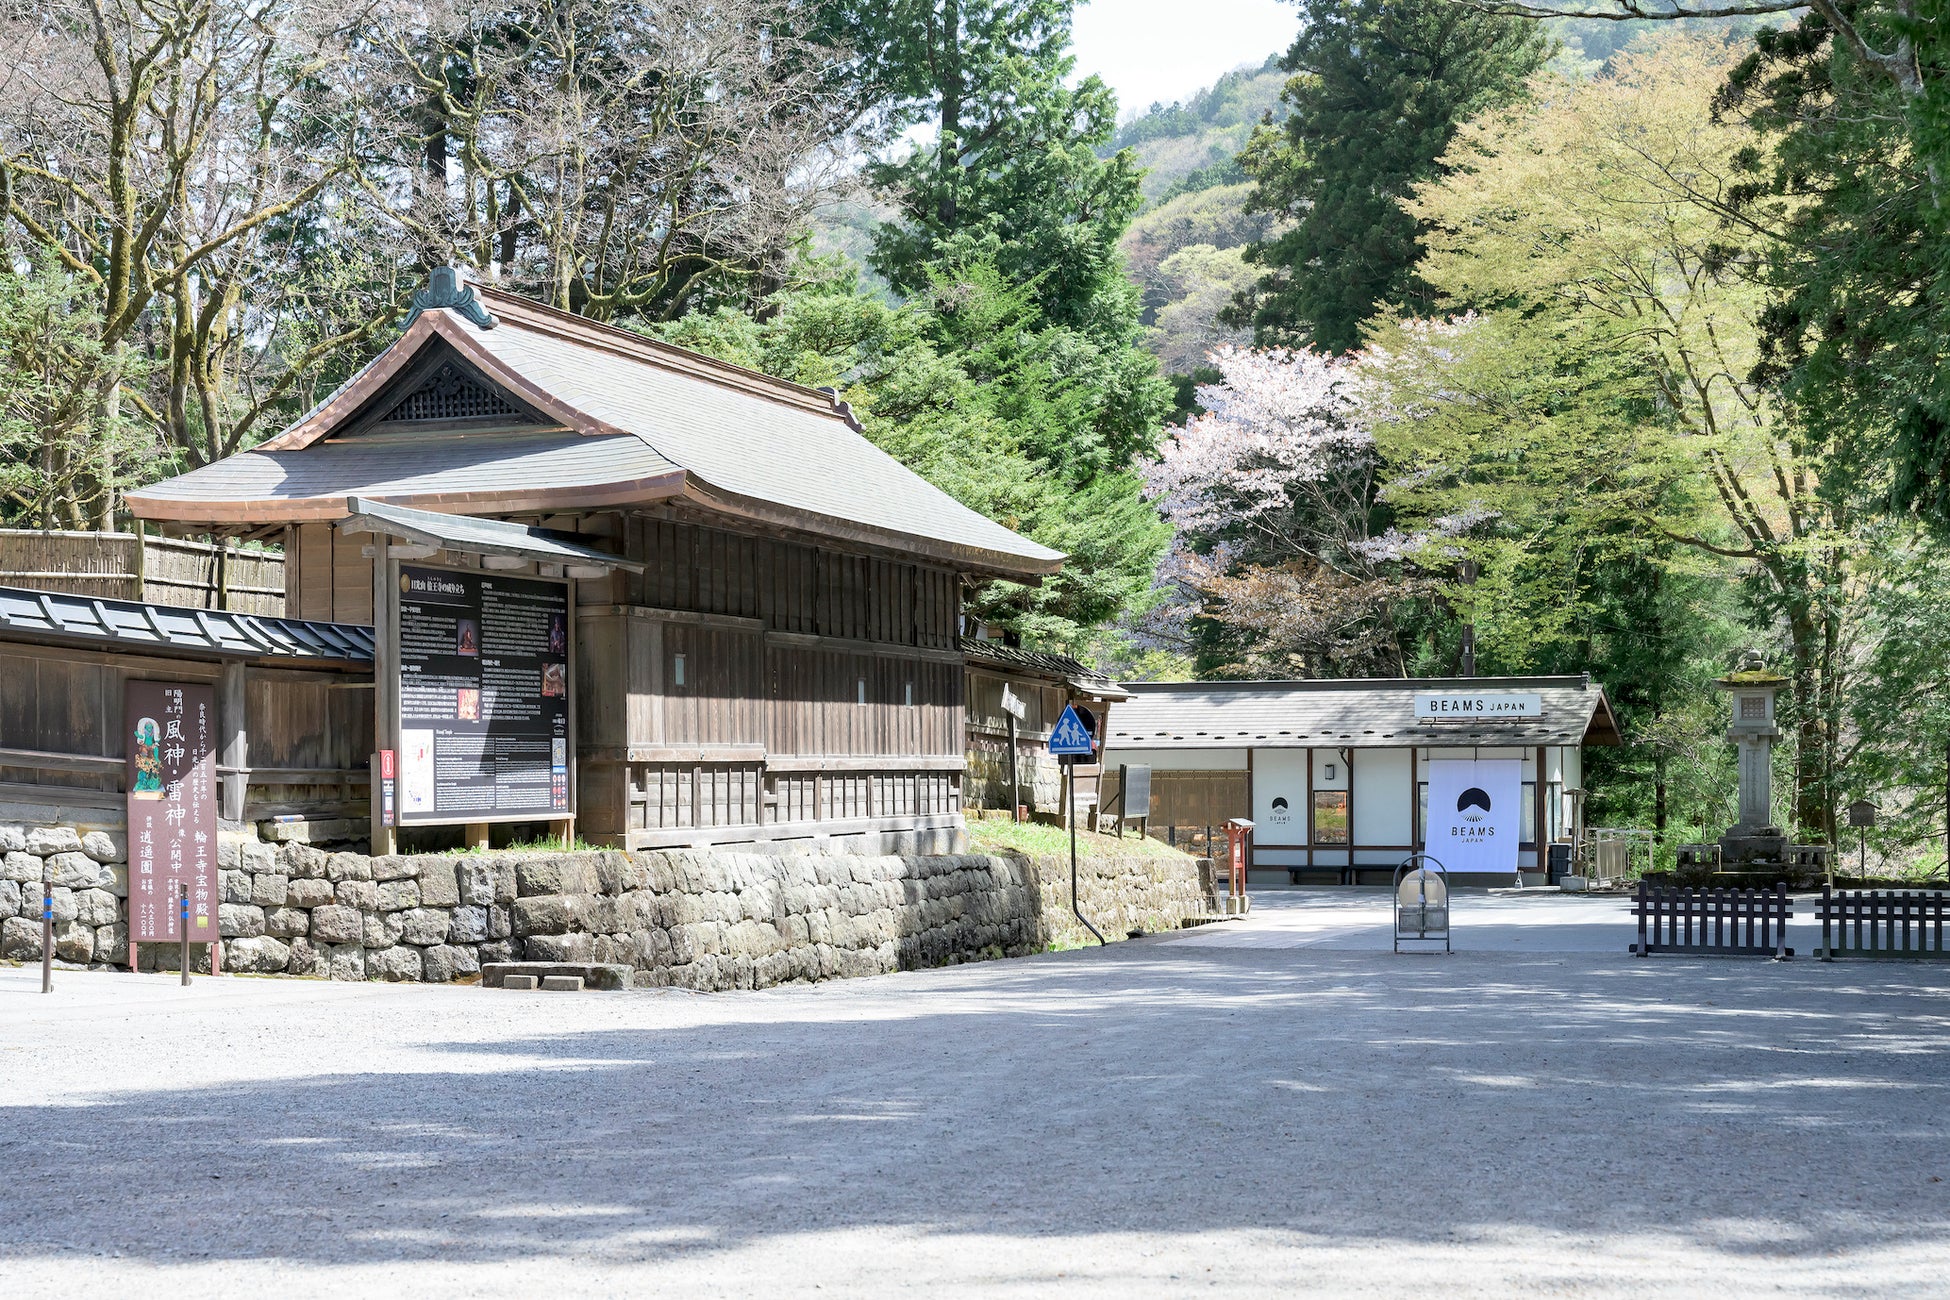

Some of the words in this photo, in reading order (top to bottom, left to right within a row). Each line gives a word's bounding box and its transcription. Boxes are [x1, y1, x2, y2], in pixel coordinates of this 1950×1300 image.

[1430, 700, 1483, 711] BEAMS
[1490, 703, 1525, 711] JAPAN
[164, 719, 186, 827] 風神・雷神
[192, 748, 200, 824] 日光山の歴史を伝える
[199, 702, 208, 800] 奈良時代から千二百五十年の
[170, 838, 183, 873] 公開中
[1451, 826, 1495, 836] BEAMS
[194, 830, 209, 916] 輪王寺宝物殿
